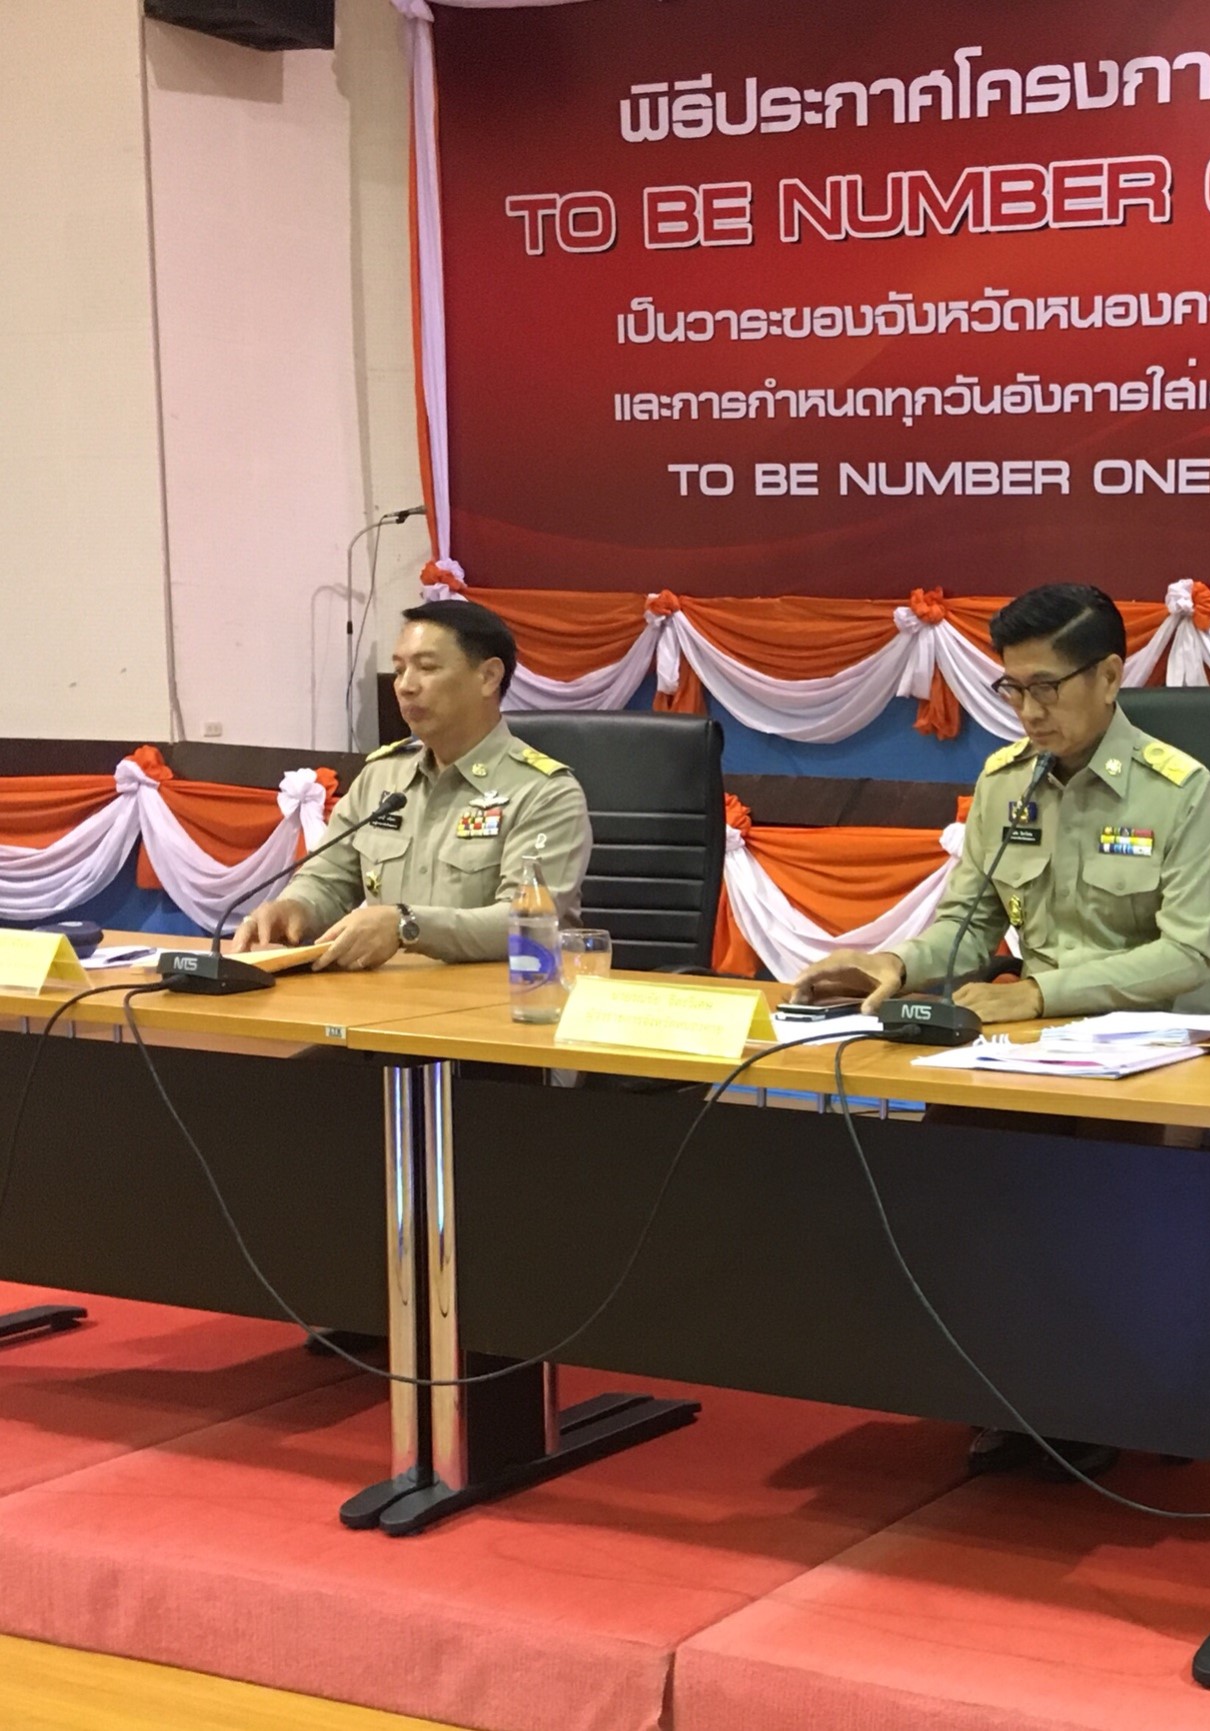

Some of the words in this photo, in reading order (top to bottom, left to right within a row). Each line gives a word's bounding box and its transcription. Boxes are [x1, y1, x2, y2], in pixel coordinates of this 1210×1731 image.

[506, 191, 616, 255] TO
[643, 181, 753, 249] BE
[779, 154, 1173, 243] NUMBER
[667, 463, 734, 496] TO
[755, 462, 819, 496] BE
[839, 460, 1070, 496] NUMBER
